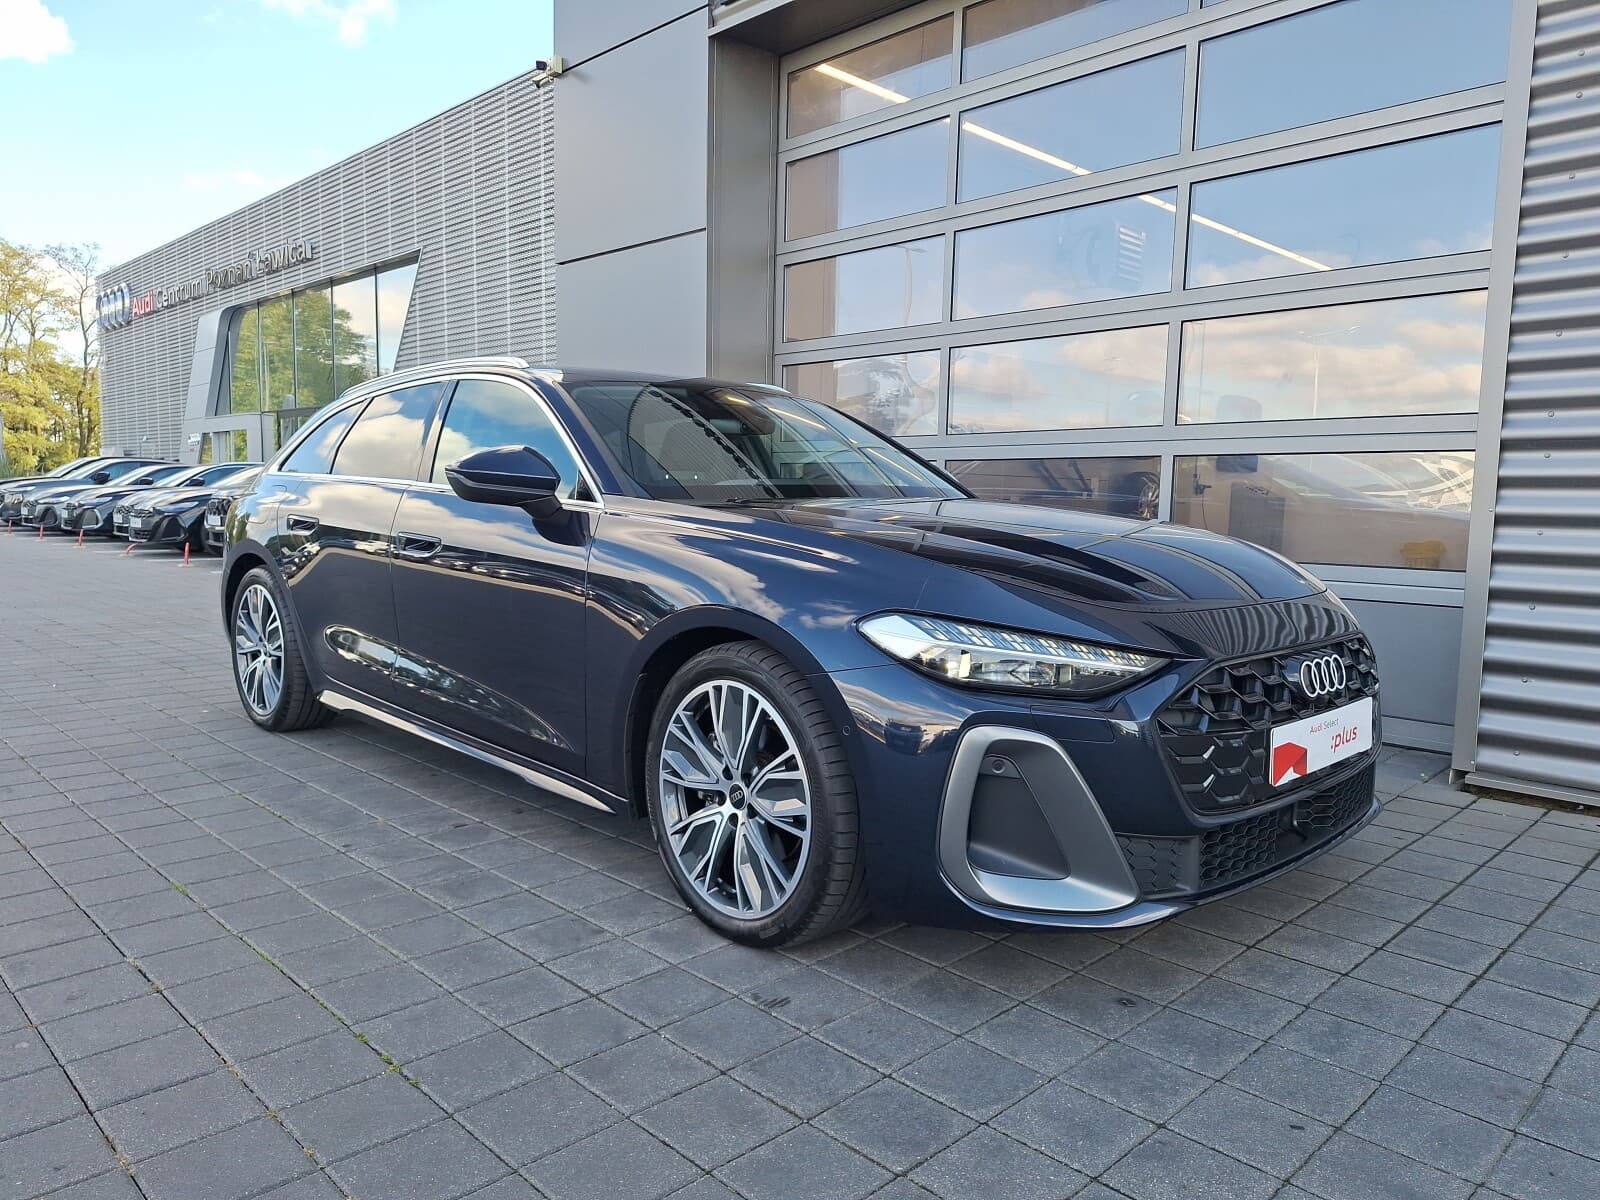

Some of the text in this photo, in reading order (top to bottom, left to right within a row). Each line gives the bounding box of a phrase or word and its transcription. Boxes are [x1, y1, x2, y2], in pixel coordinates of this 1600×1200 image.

[132, 290, 154, 317] Audi
[155, 279, 203, 307] Centrum
[1310, 717, 1340, 734] Audi Select
[1330, 726, 1358, 753] :plus
